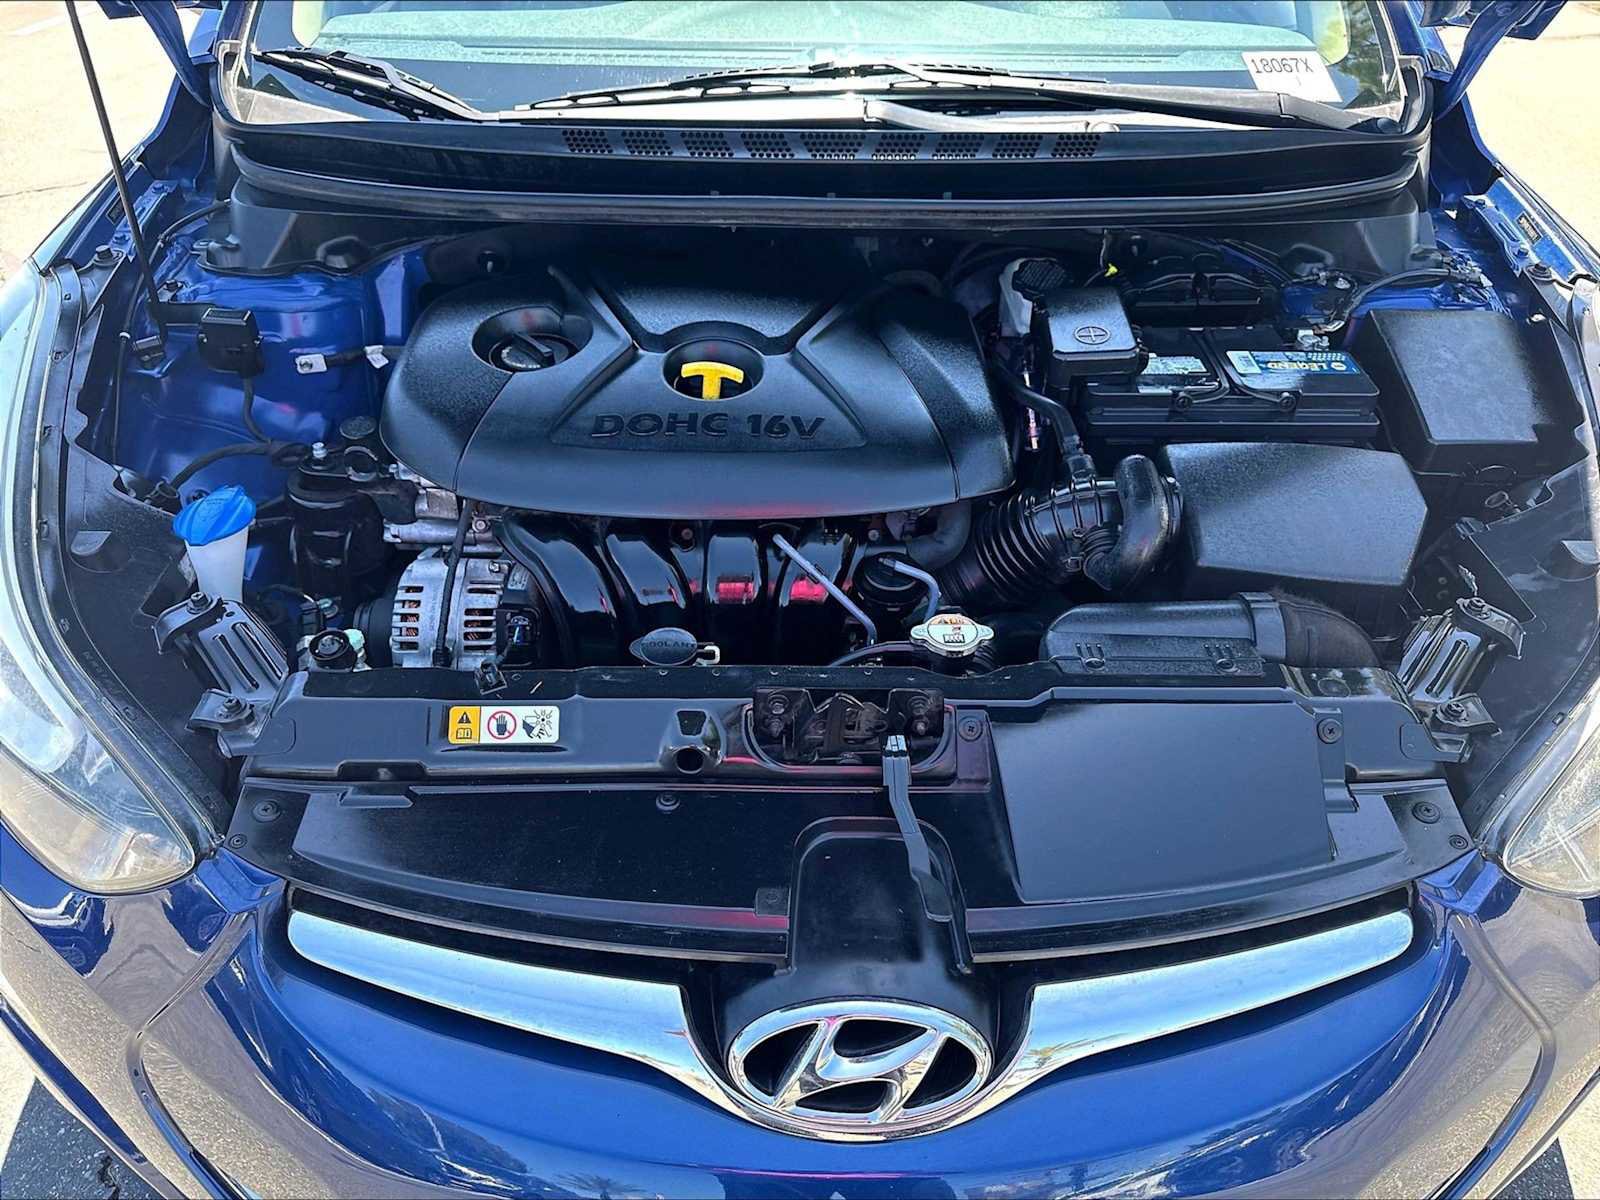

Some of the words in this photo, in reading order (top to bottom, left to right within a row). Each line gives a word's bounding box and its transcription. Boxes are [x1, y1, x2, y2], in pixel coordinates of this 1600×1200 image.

[1251, 57, 1314, 74] 18067X
[1267, 360, 1329, 371] LEGEND
[592, 412, 729, 438] DOHC
[747, 413, 826, 440] 16V
